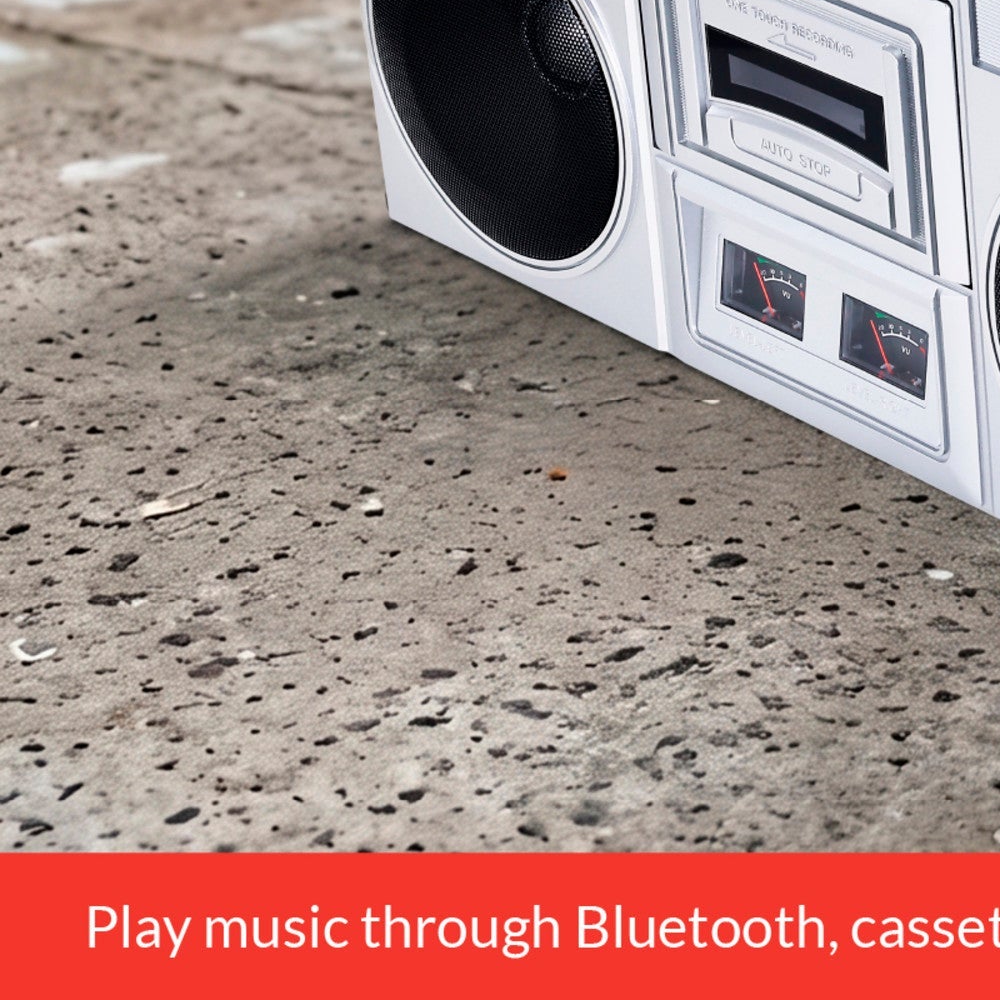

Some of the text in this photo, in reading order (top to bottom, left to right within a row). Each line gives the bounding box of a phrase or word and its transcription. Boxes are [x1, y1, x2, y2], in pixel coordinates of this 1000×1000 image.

[750, 5, 788, 33] TOUCH
[790, 15, 855, 60] RECORDING
[760, 137, 832, 177] AUTO STOP
[901, 345, 911, 356] VU
